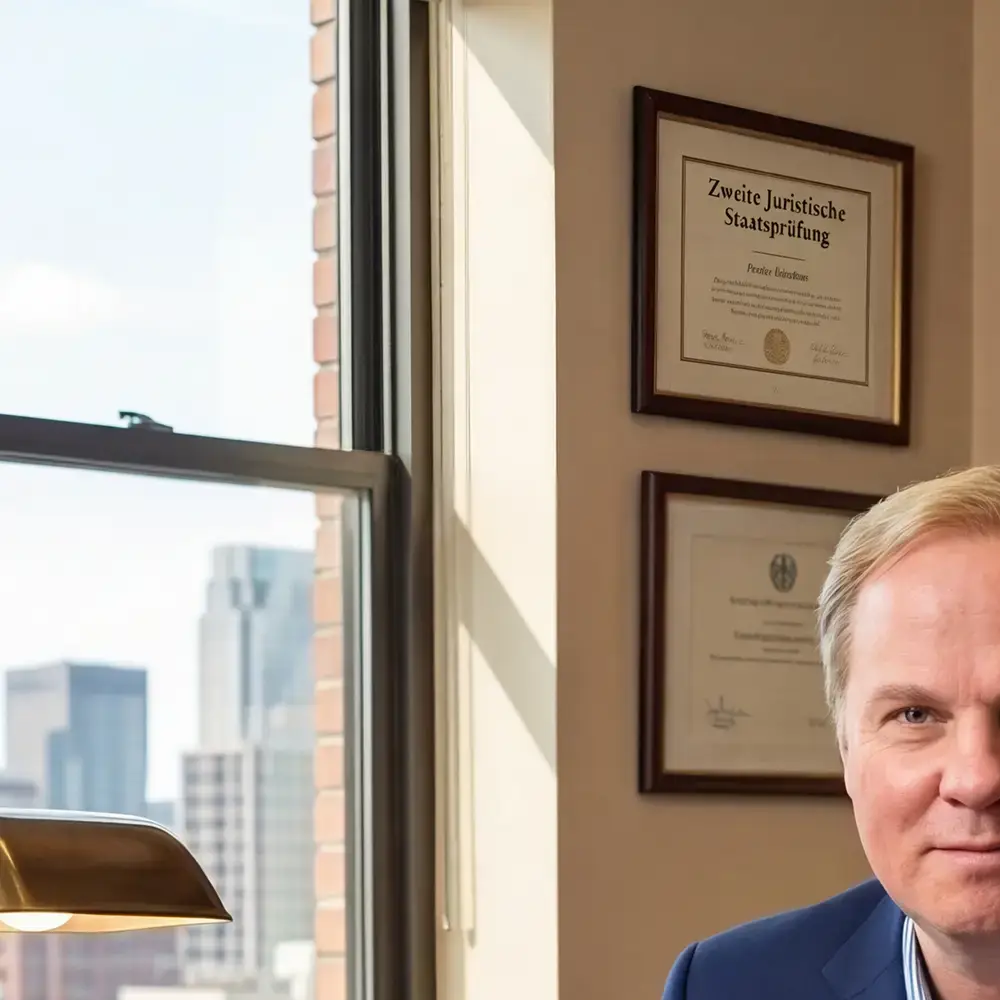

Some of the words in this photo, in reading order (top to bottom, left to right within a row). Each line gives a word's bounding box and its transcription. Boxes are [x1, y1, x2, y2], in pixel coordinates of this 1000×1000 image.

[708, 177, 761, 206] Zweite
[764, 189, 847, 222] Juristische
[724, 207, 831, 249] Staatsprüfung
